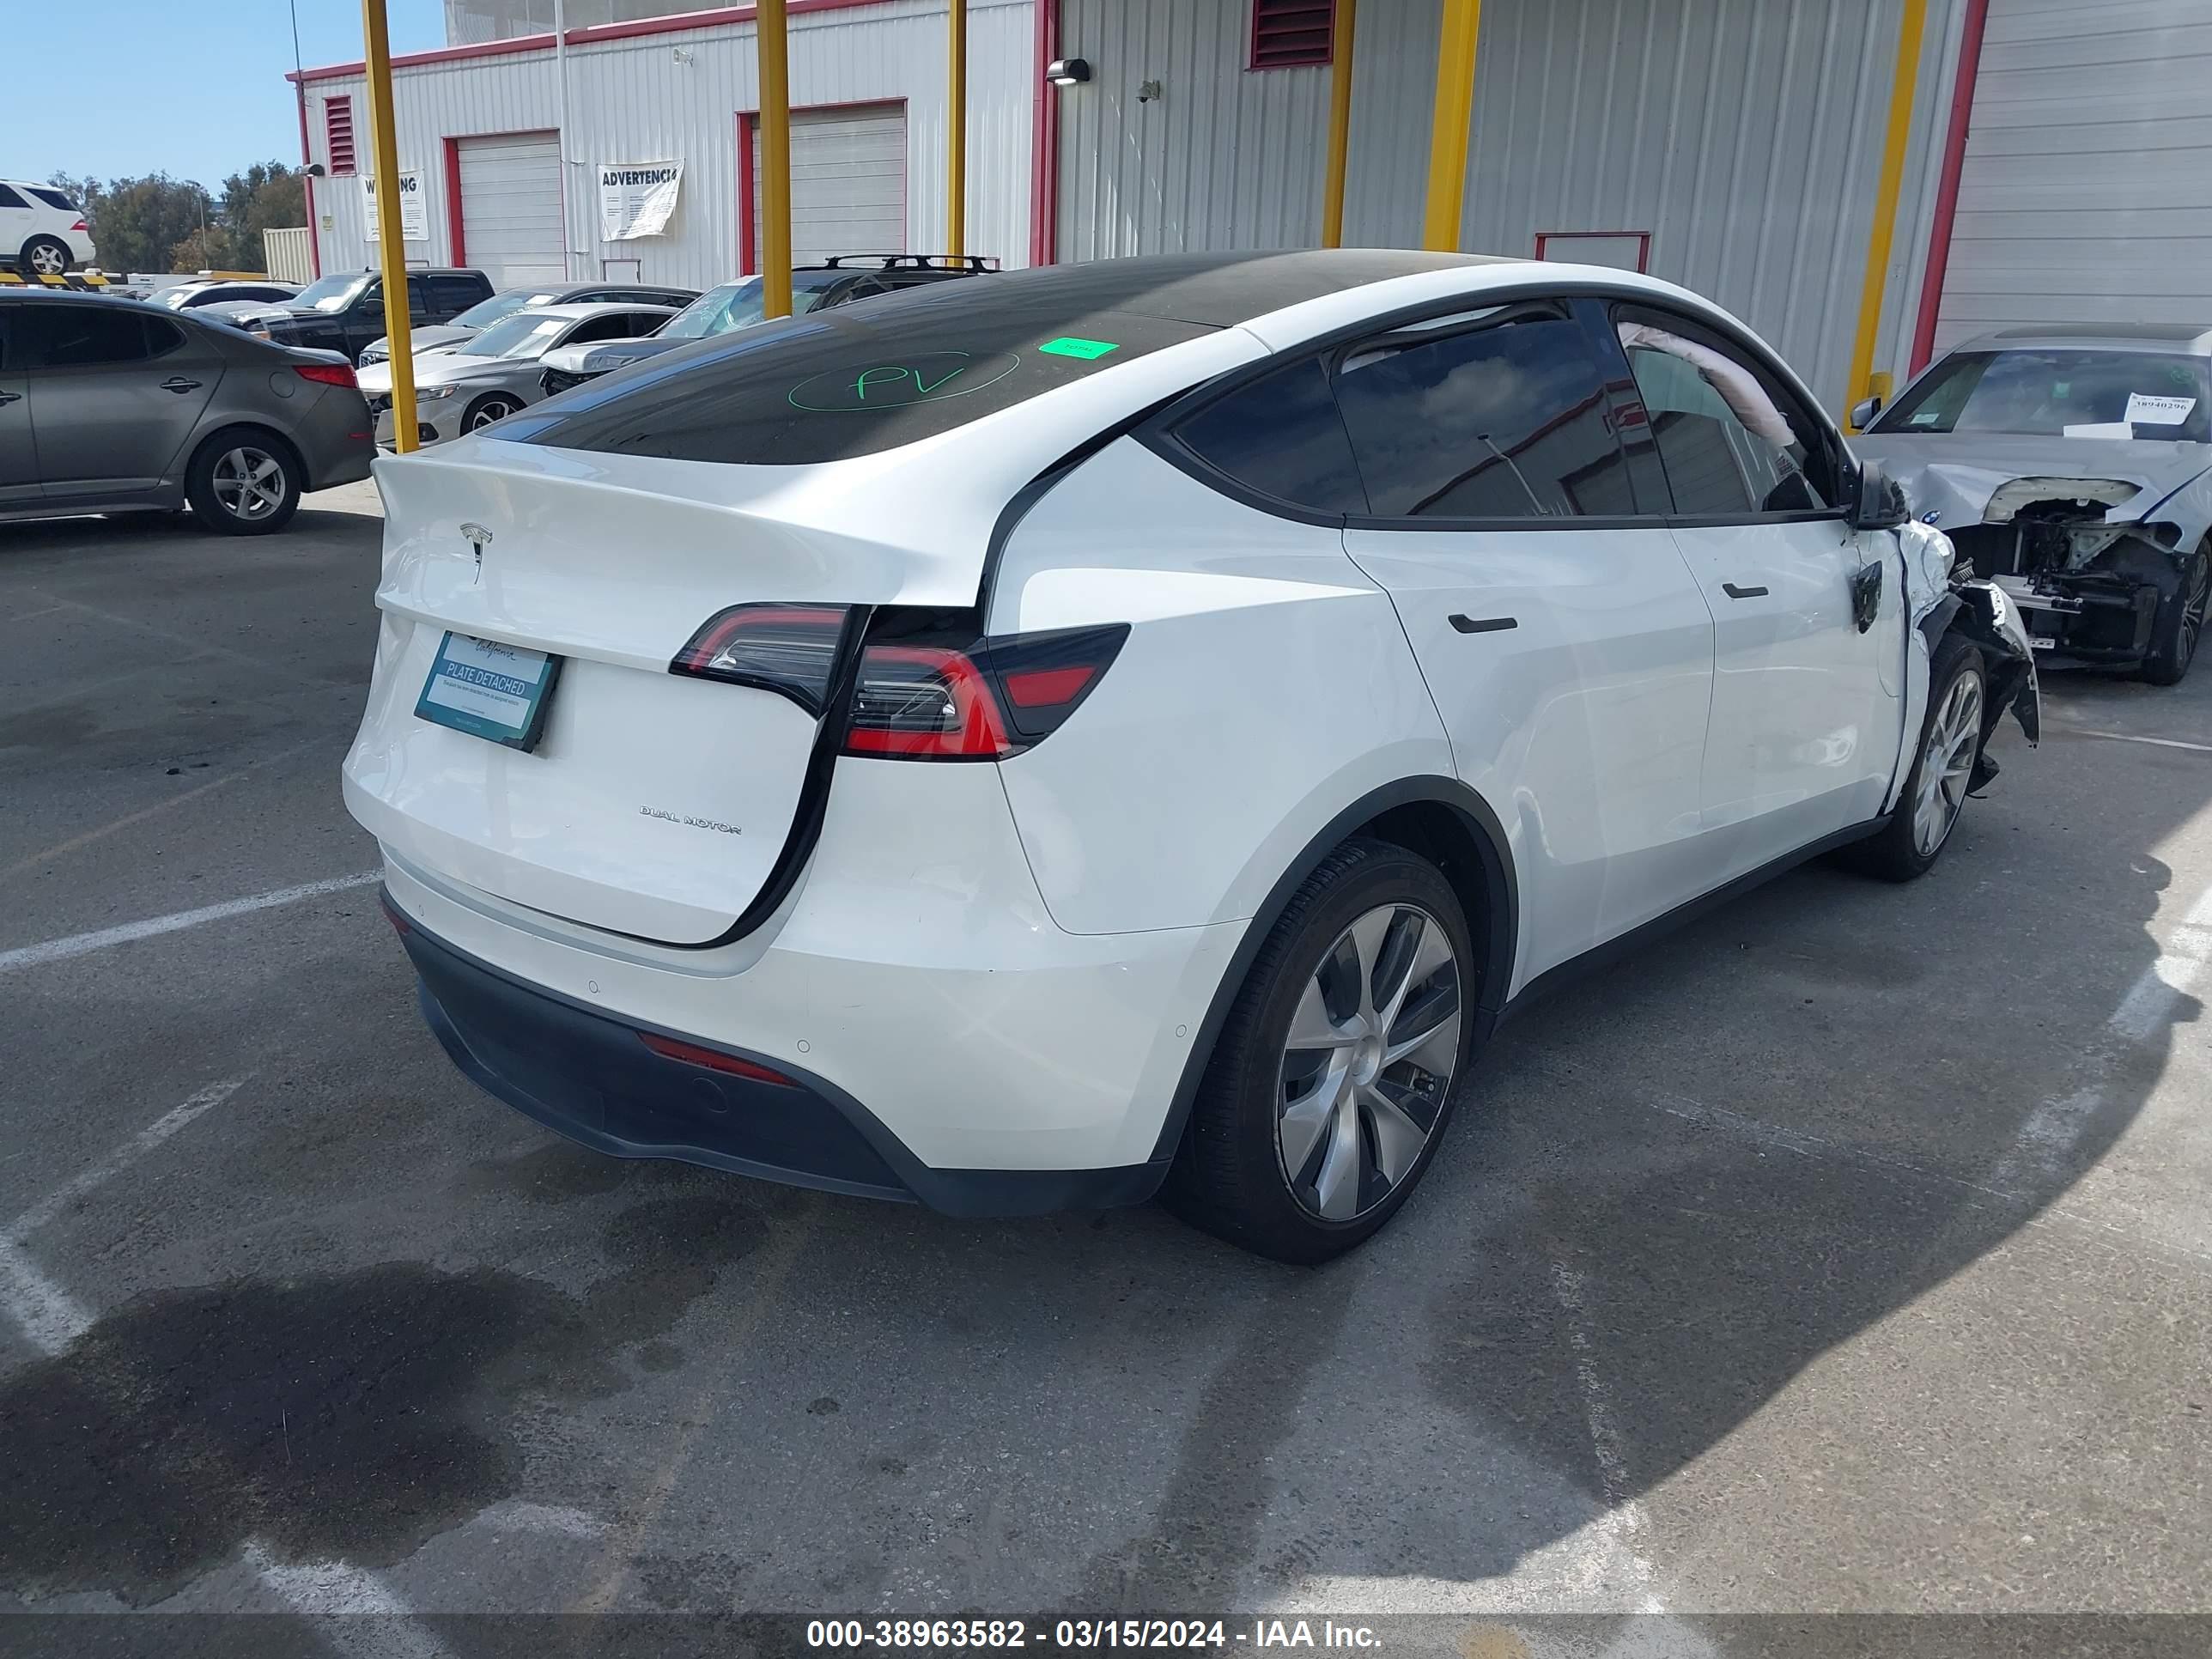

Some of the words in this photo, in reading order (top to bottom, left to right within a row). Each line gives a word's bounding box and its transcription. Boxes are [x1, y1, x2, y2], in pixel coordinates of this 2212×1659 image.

[848, 367, 965, 399] PV
[447, 663, 476, 681] PLATE
[476, 671, 526, 696] DETACHED
[640, 805, 680, 823] DUAL
[684, 816, 743, 836] MOTOR
